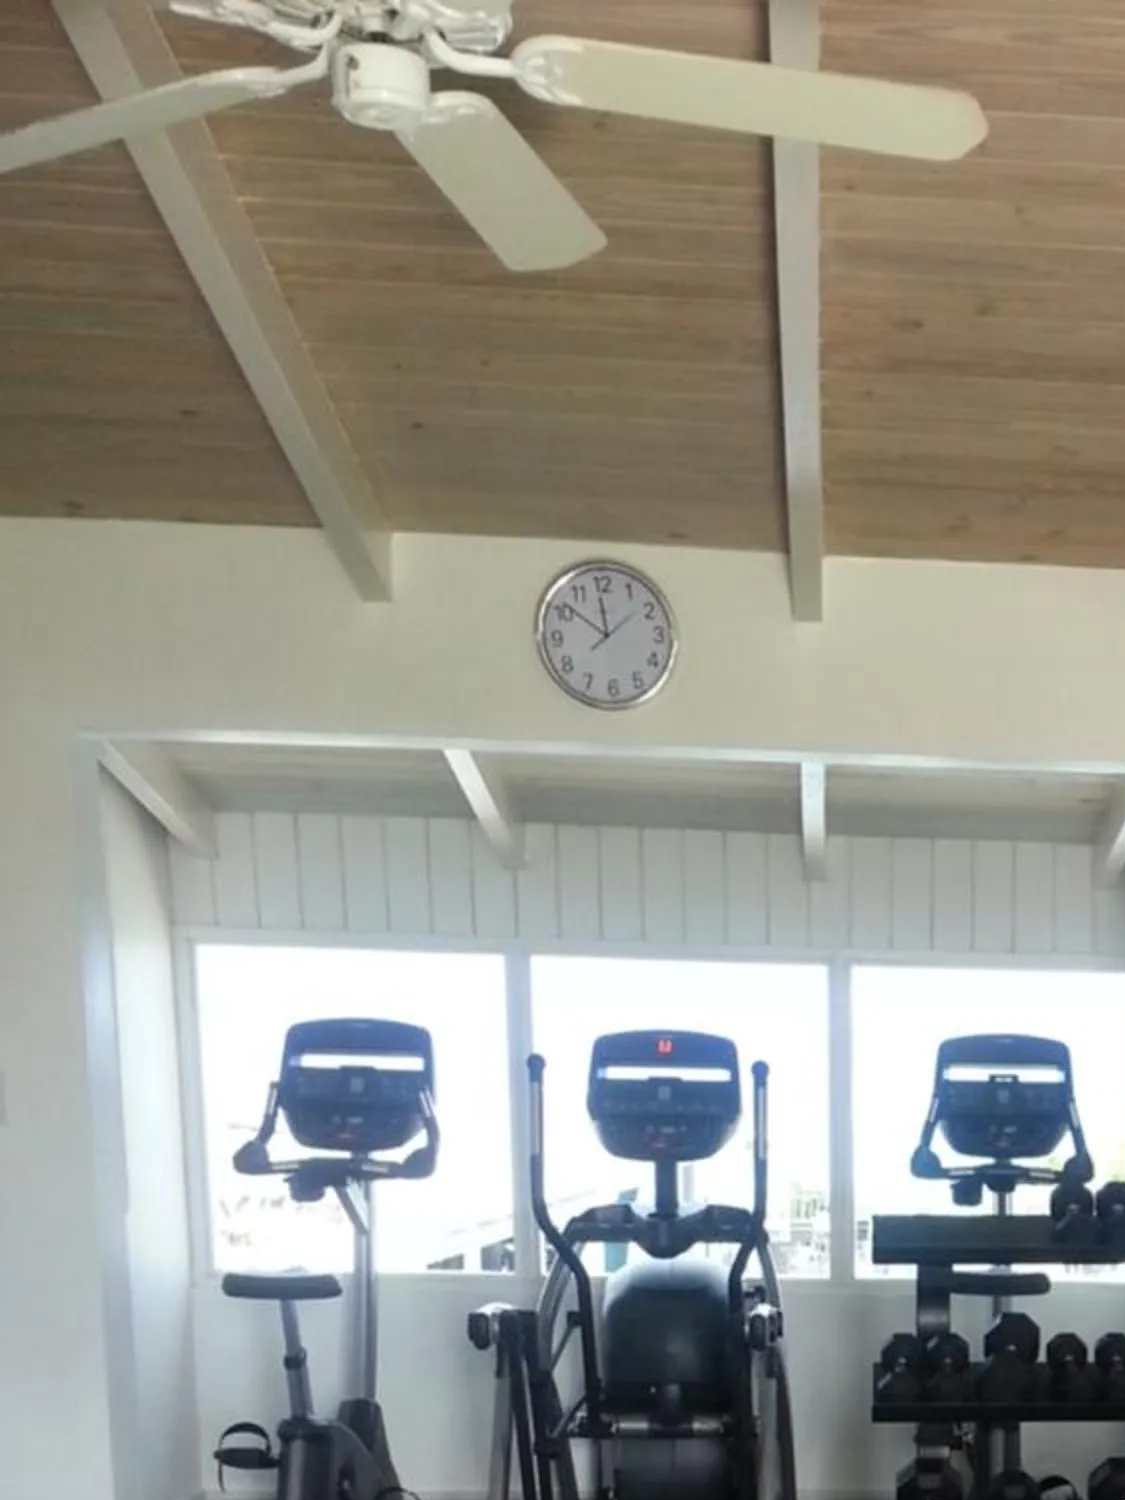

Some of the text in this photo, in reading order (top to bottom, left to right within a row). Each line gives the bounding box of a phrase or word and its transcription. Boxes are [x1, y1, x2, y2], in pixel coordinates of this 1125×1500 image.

[571, 584, 586, 602] 11
[592, 575, 612, 593] 12
[625, 582, 633, 600] 1
[554, 602, 574, 622] 10
[642, 601, 656, 621] 2
[550, 629, 564, 648] 9
[652, 625, 664, 644] 3
[560, 654, 574, 673] 8
[646, 651, 659, 668] 4
[583, 672, 594, 690] 7
[607, 678, 620, 697] 6
[632, 671, 644, 689] 5
